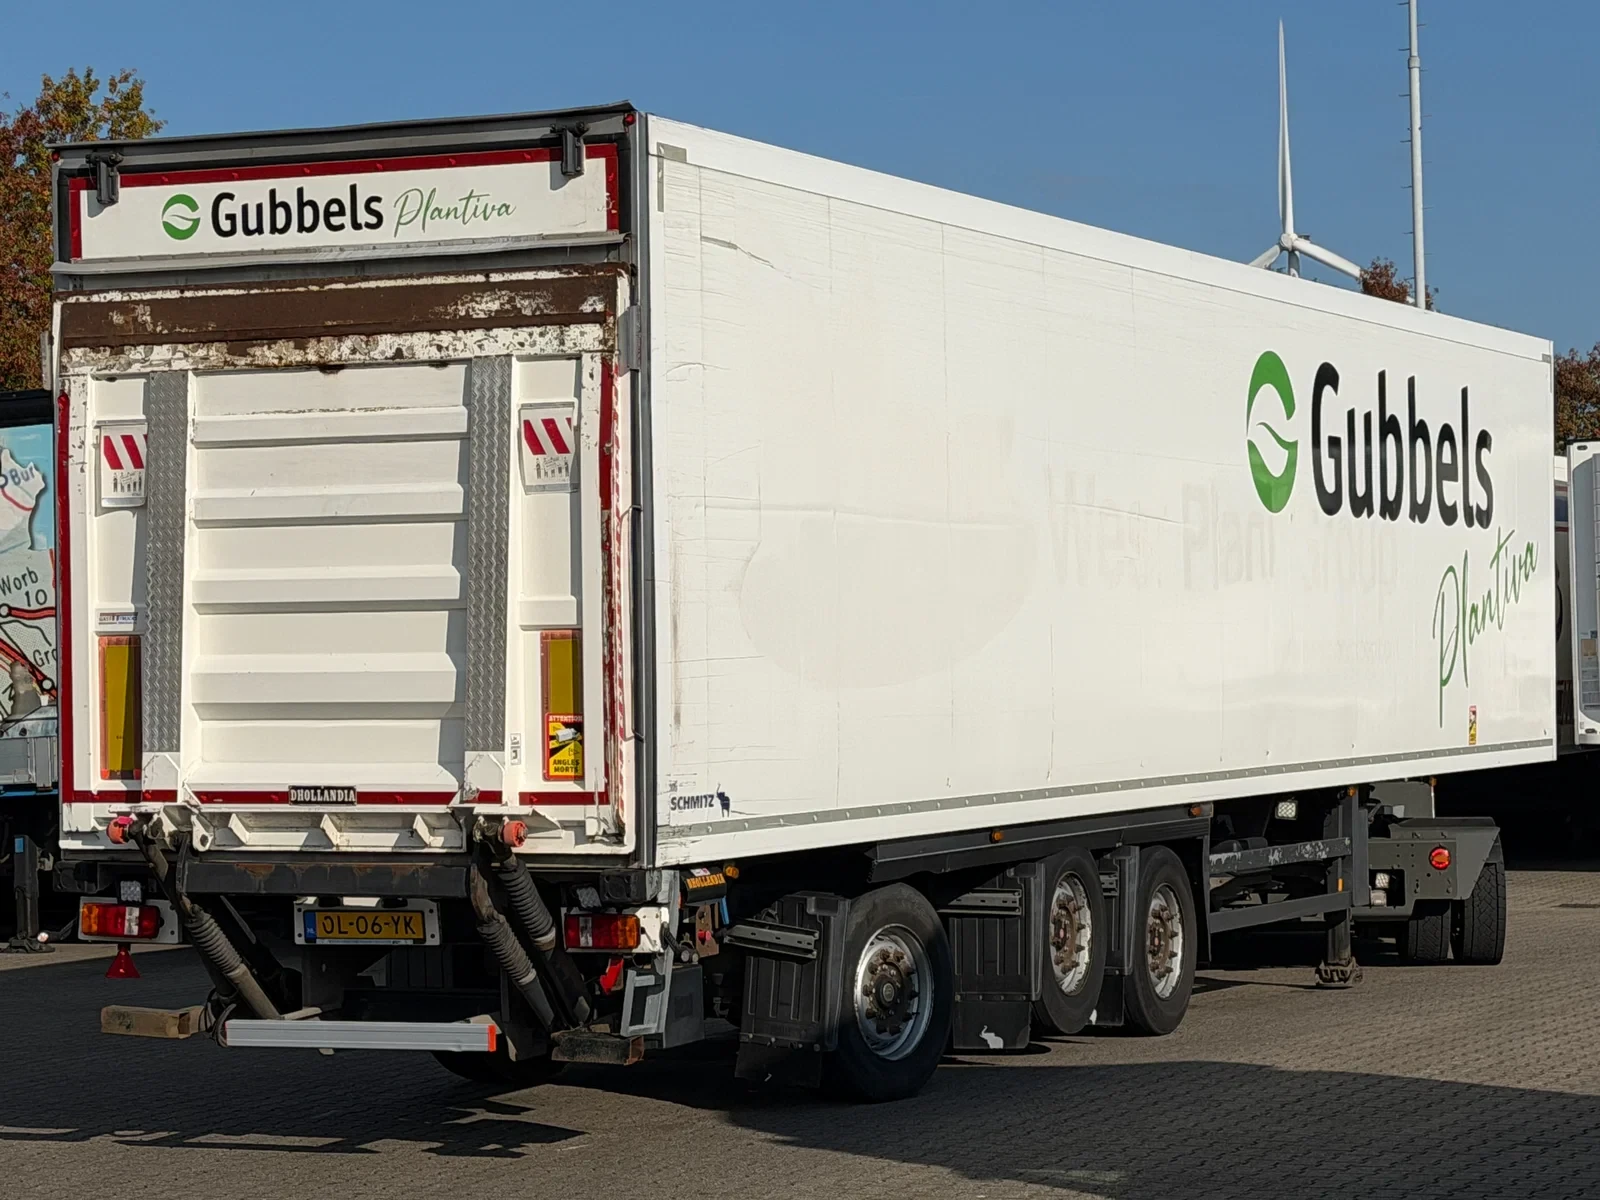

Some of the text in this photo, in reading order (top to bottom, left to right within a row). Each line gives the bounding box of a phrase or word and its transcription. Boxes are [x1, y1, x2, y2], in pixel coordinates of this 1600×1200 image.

[211, 184, 517, 238] Gubbels Plantiva
[1311, 362, 1493, 529] Gubbels
[24, 588, 48, 607] 10
[1432, 526, 1538, 728] Plantiva
[290, 789, 356, 802] DHOLLANDIA
[670, 795, 714, 811] SCHMITZ
[322, 915, 416, 935] OL-06-YK
